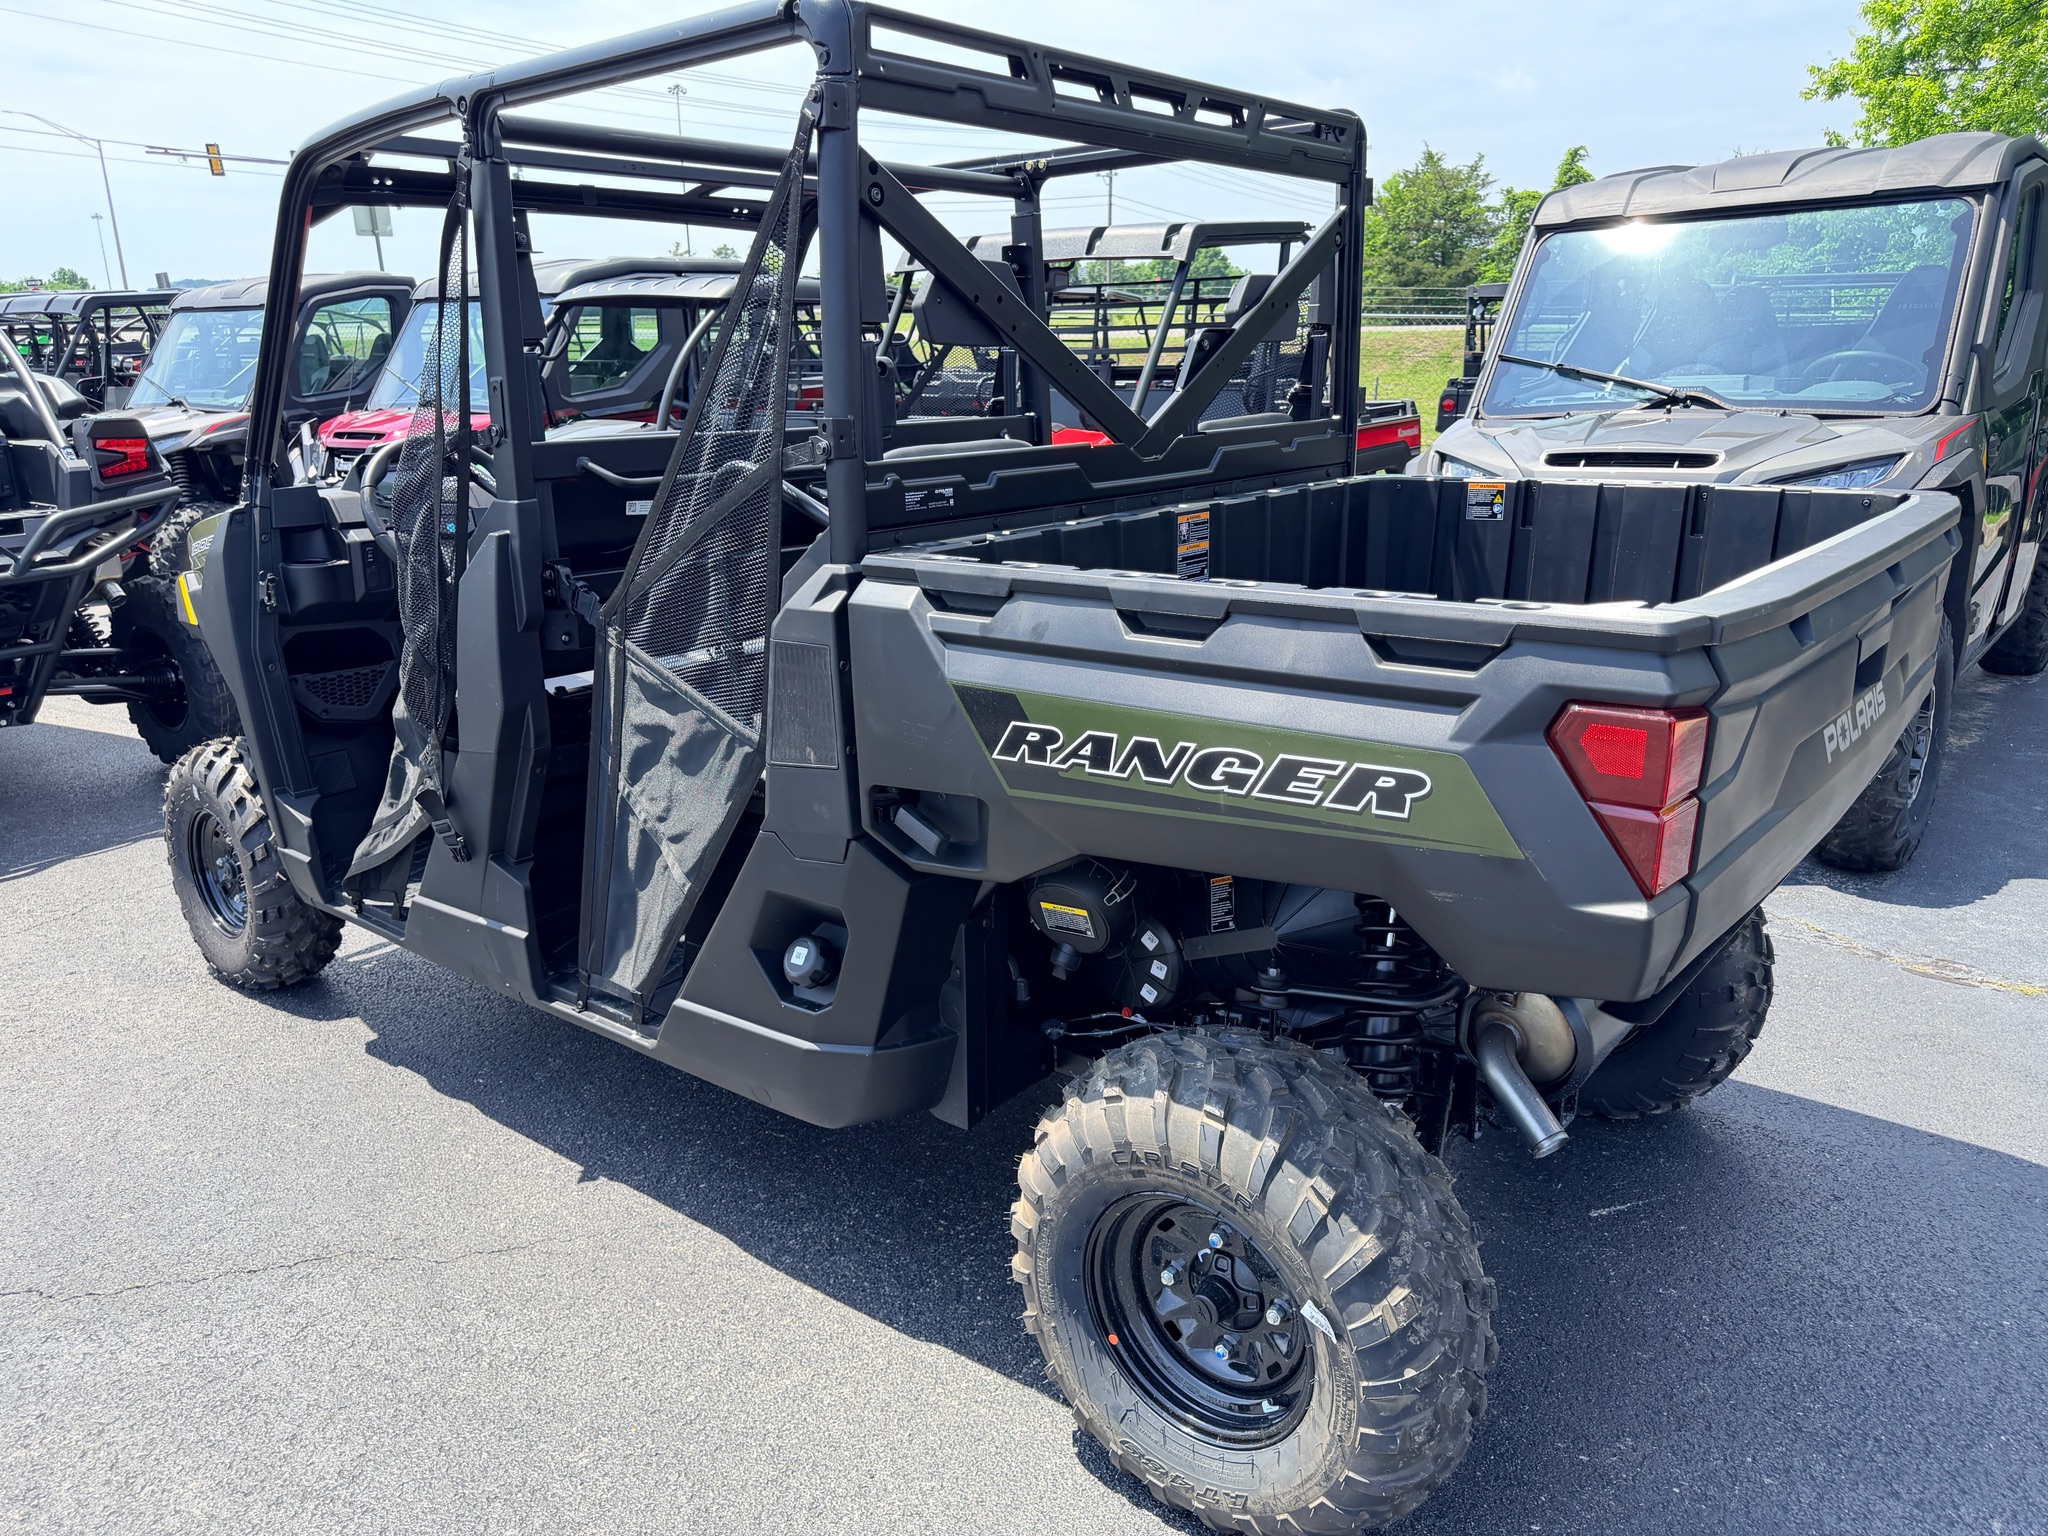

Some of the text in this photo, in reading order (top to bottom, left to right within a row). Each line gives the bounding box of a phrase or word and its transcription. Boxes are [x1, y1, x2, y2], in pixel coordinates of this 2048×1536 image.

[1823, 679, 1886, 764] POLARIS
[991, 721, 1432, 819] RANGER
[1111, 1150, 1254, 1211] CARLSTAR
